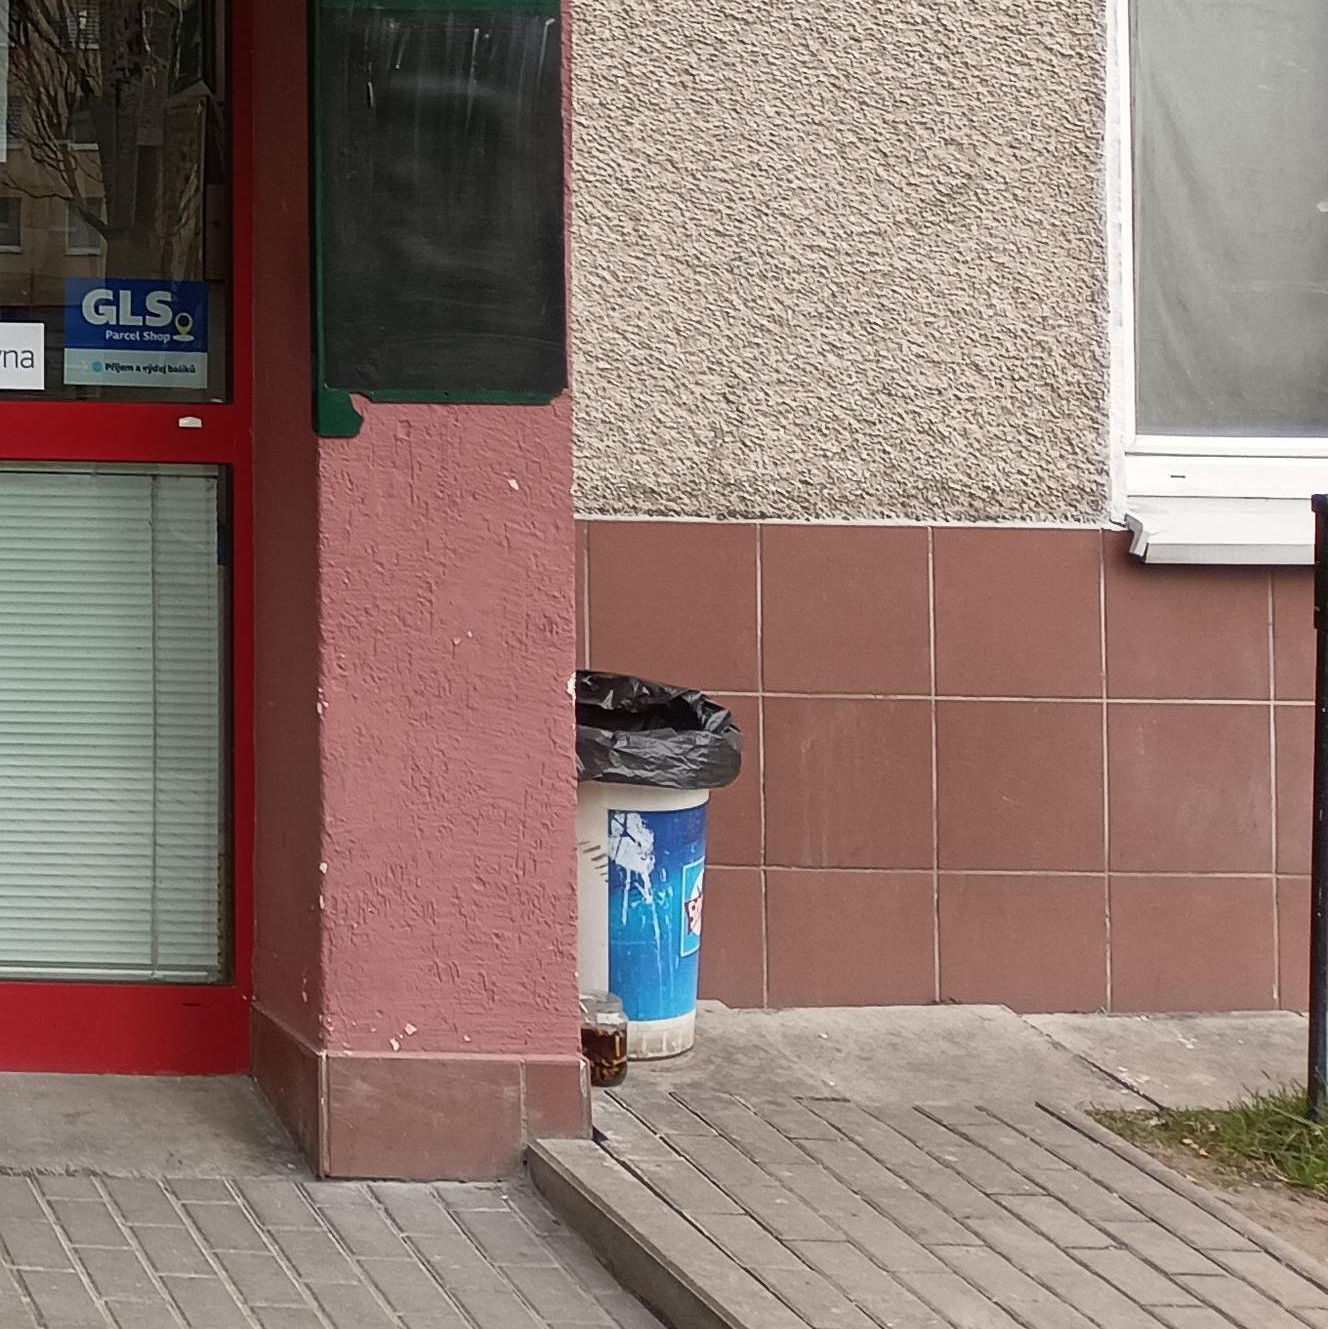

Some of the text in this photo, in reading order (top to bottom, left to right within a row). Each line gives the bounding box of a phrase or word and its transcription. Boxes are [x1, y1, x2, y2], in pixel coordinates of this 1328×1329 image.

[81, 288, 173, 327] GLS
[105, 330, 171, 343] Parcel Shop
